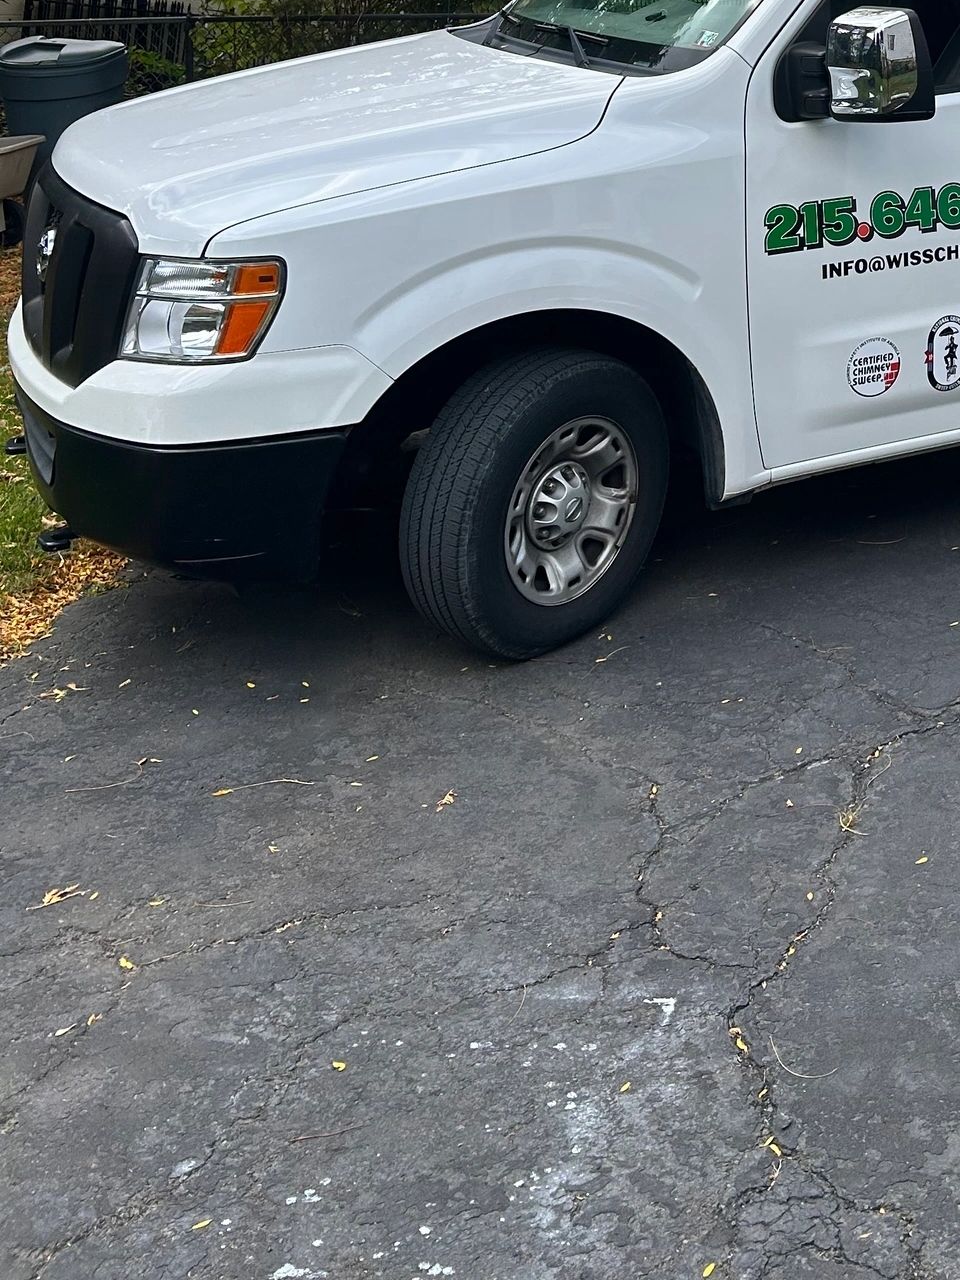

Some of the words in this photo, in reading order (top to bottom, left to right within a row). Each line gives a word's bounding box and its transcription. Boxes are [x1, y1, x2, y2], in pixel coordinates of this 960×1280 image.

[853, 353, 894, 367] CERTIFIED
[853, 362, 891, 376] CHIMNEY
[852, 373, 884, 386] SWEEP.
